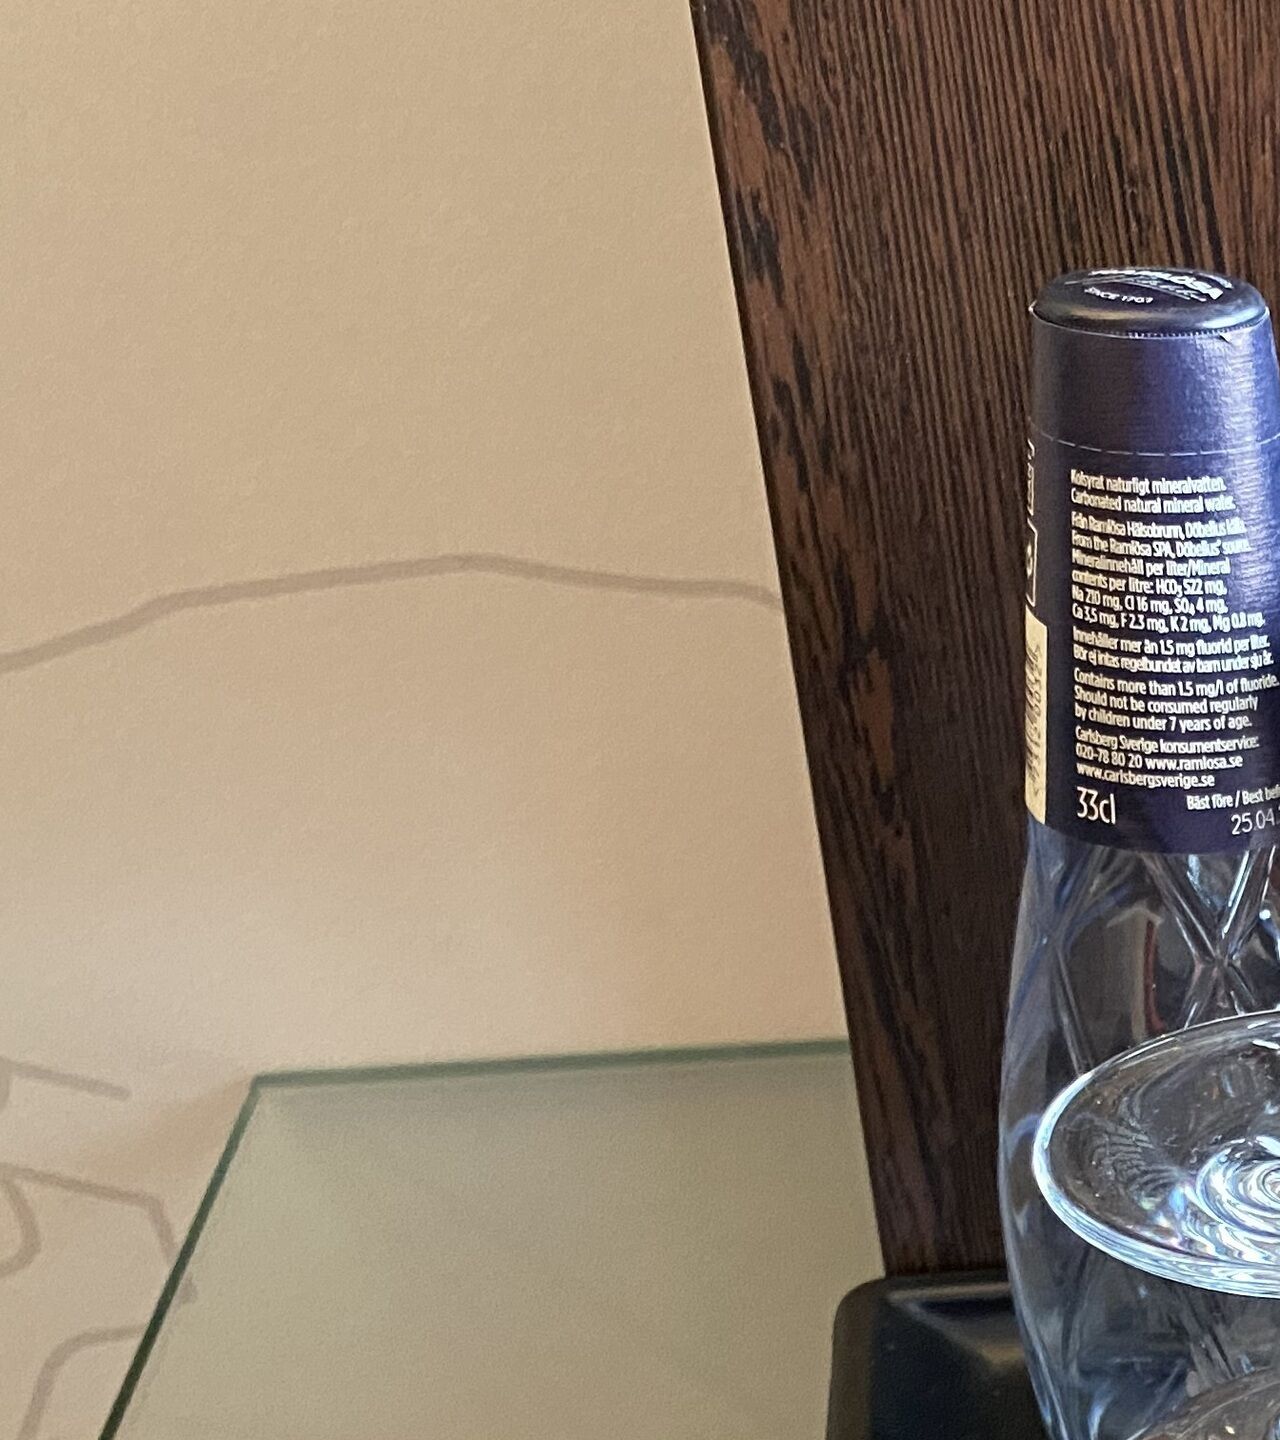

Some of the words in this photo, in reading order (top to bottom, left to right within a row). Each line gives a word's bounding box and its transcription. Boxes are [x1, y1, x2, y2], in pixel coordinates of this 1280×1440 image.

[1123, 496, 1161, 513] natural
[1163, 495, 1204, 513] mineral
[1145, 562, 1164, 577] per
[1109, 578, 1126, 591] per
[1121, 640, 1142, 653] mer
[1175, 642, 1196, 657] mg
[1074, 667, 1115, 690] Contains
[1117, 680, 1147, 695] more
[1148, 680, 1176, 696] than
[1225, 678, 1239, 694] of
[1074, 685, 1107, 707] Should
[1109, 696, 1128, 710] not
[1130, 696, 1145, 712] be
[1147, 698, 1208, 714] consumed
[1209, 693, 1259, 714] regularly
[1075, 702, 1087, 721] by
[1088, 707, 1131, 727] children
[1132, 715, 1168, 731] under
[1168, 716, 1177, 732] 7
[1179, 718, 1212, 734] years
[1213, 715, 1226, 730] of
[1227, 715, 1253, 730] age.
[1075, 725, 1118, 749] Carlsberg
[1119, 735, 1159, 753] Sverige
[1111, 753, 1126, 767] 80
[1128, 754, 1143, 769] 20
[1145, 755, 1244, 771] www.ramlosa.se
[1076, 762, 1216, 789] www.carlsbergsverige.se
[1077, 786, 1117, 825] 33cl
[1241, 788, 1264, 806] Best
